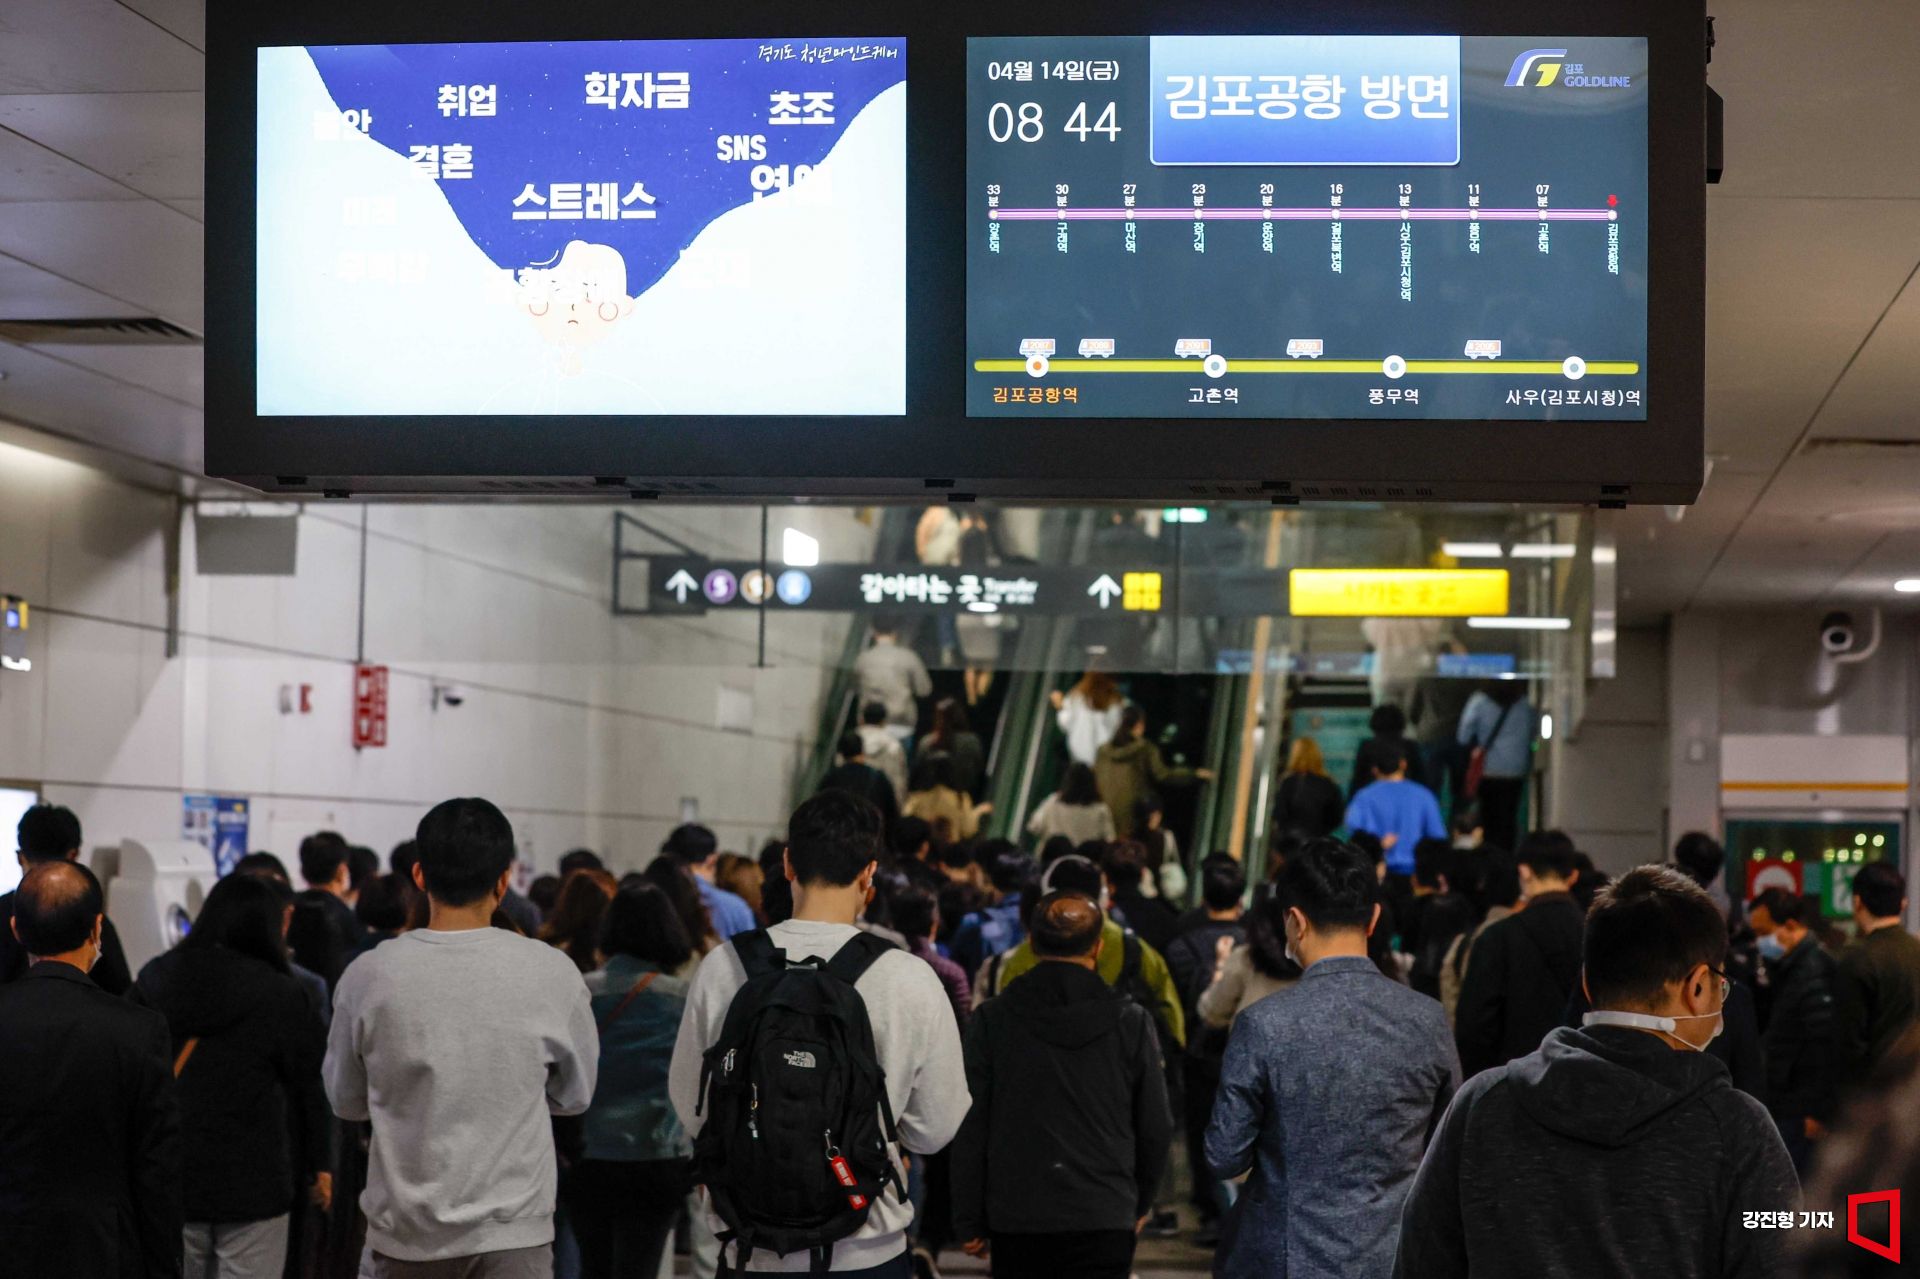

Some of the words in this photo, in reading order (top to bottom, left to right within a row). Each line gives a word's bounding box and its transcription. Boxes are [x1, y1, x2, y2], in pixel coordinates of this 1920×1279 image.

[758, 43, 797, 63] 경기도
[987, 61, 1033, 82] 04월
[1040, 60, 1120, 81] 14일(금)
[1564, 63, 1585, 75] 김포
[584, 71, 691, 110] 학자금
[1563, 76, 1631, 88] GOLDLINE
[437, 84, 497, 117] 취업
[1165, 74, 1346, 120] 김포공항
[1360, 74, 1449, 120] 방면
[768, 90, 835, 125] 초조
[987, 102, 1044, 142] 08
[1063, 101, 1122, 142] 44
[716, 134, 767, 161] SNS
[408, 143, 474, 179] 결혼
[987, 184, 1001, 195] 33
[1055, 184, 1069, 195] 30
[1123, 184, 1137, 195] 27
[1192, 184, 1206, 195] 23
[1260, 184, 1274, 195] 20
[1330, 184, 1343, 195] 16
[1399, 184, 1412, 195] 13
[1468, 184, 1480, 195] 11
[1536, 184, 1550, 195] 07
[512, 181, 656, 221] 스트레스
[1125, 222, 1136, 253] 마산역
[1193, 222, 1205, 253] 장기역
[993, 387, 1078, 404] 김포공항역
[1188, 387, 1239, 405] 고촌역
[1368, 387, 1419, 405] 풍무역
[1505, 389, 1641, 407] 사우(김포시청)역
